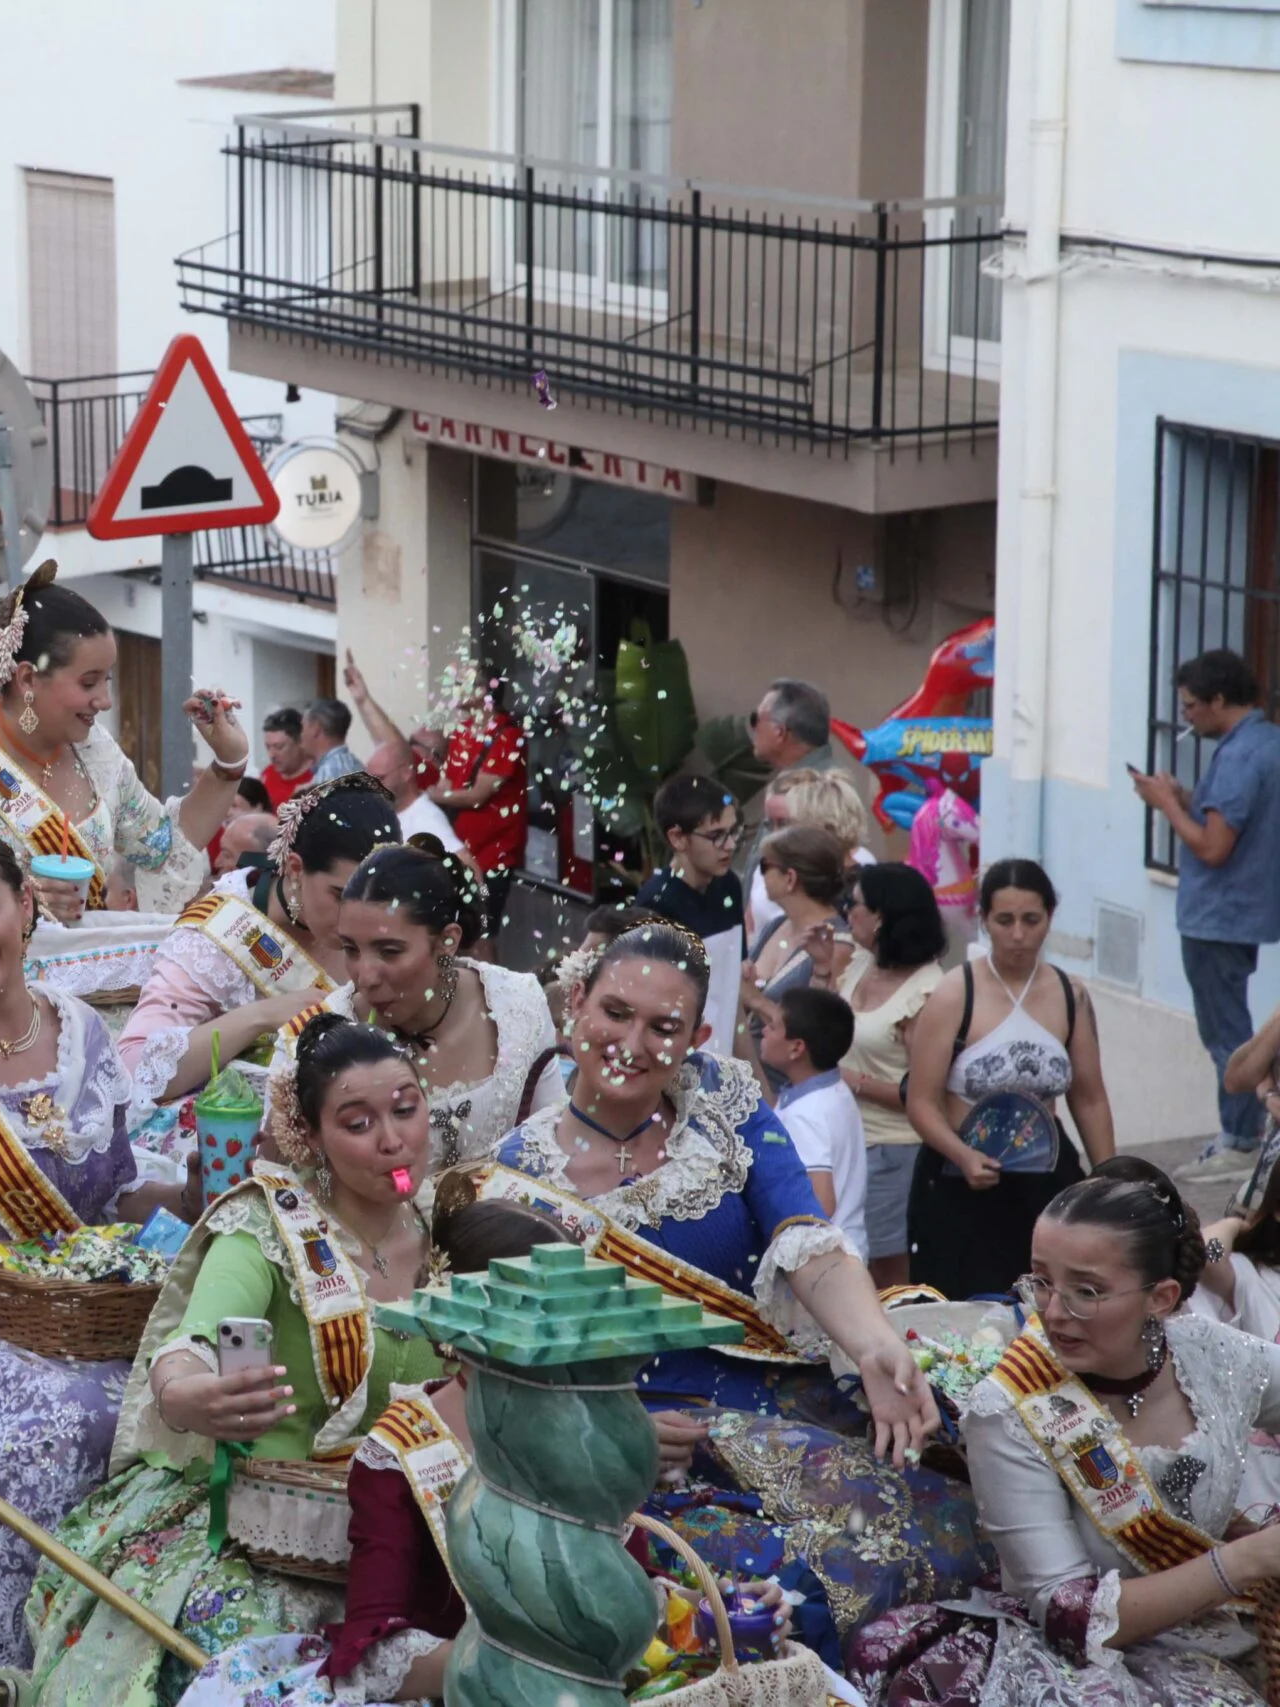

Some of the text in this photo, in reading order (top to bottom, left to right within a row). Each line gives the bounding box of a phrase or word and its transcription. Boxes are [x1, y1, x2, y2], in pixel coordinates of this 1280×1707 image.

[296, 491, 343, 507] TURIA
[10, 792, 32, 812] 2018
[270, 957, 294, 982] 2018
[315, 1275, 346, 1293] 2018
[1097, 1482, 1132, 1507] 2018
